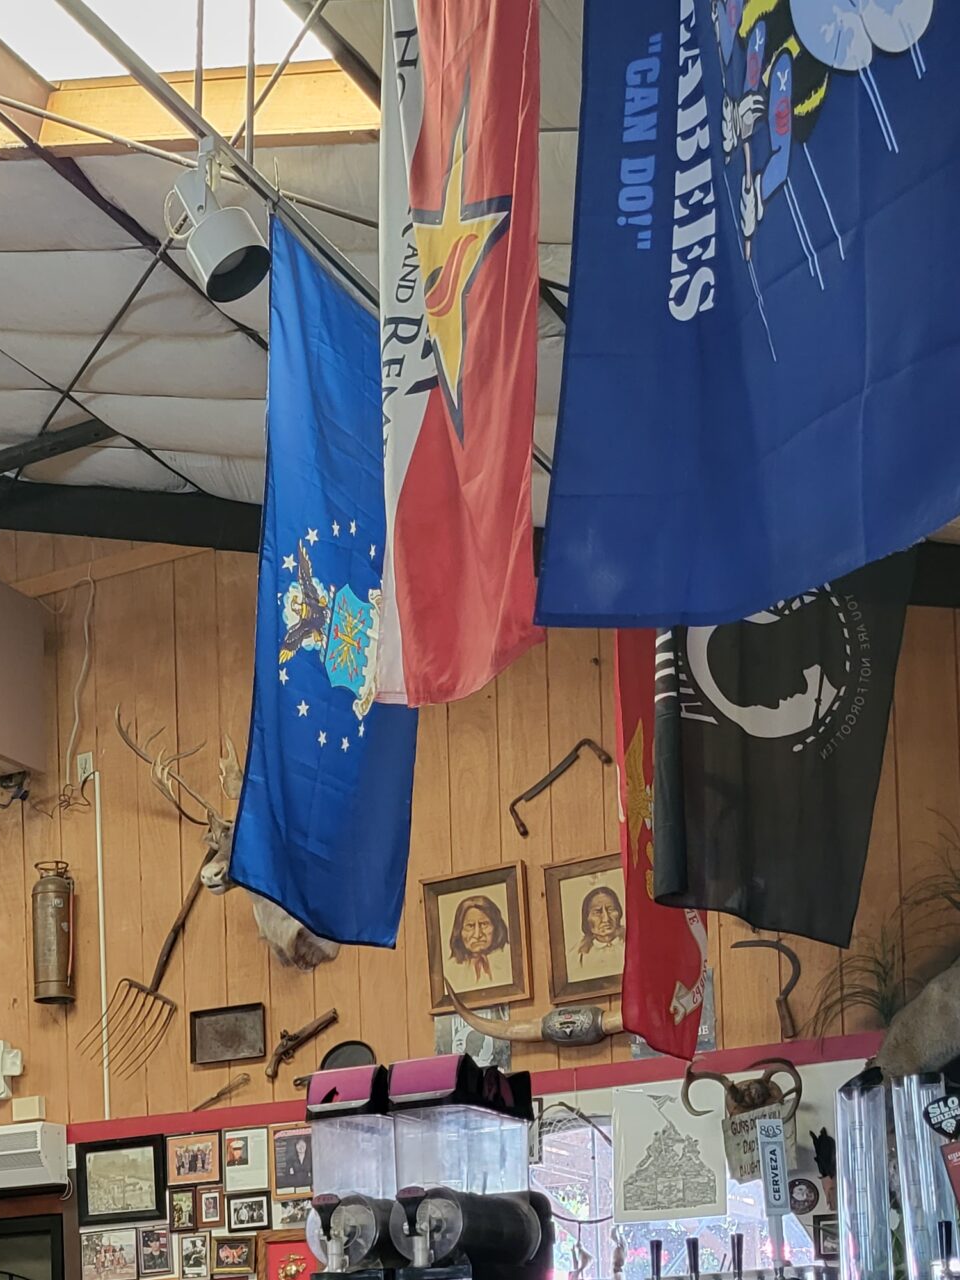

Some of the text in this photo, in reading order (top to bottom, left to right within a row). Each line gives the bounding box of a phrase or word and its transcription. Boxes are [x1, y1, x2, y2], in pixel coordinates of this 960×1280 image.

[395, 242, 420, 303] AND
[927, 1096, 959, 1118] SLO
[760, 1124, 782, 1138] 805
[770, 1148, 781, 1201] CERVEZA
